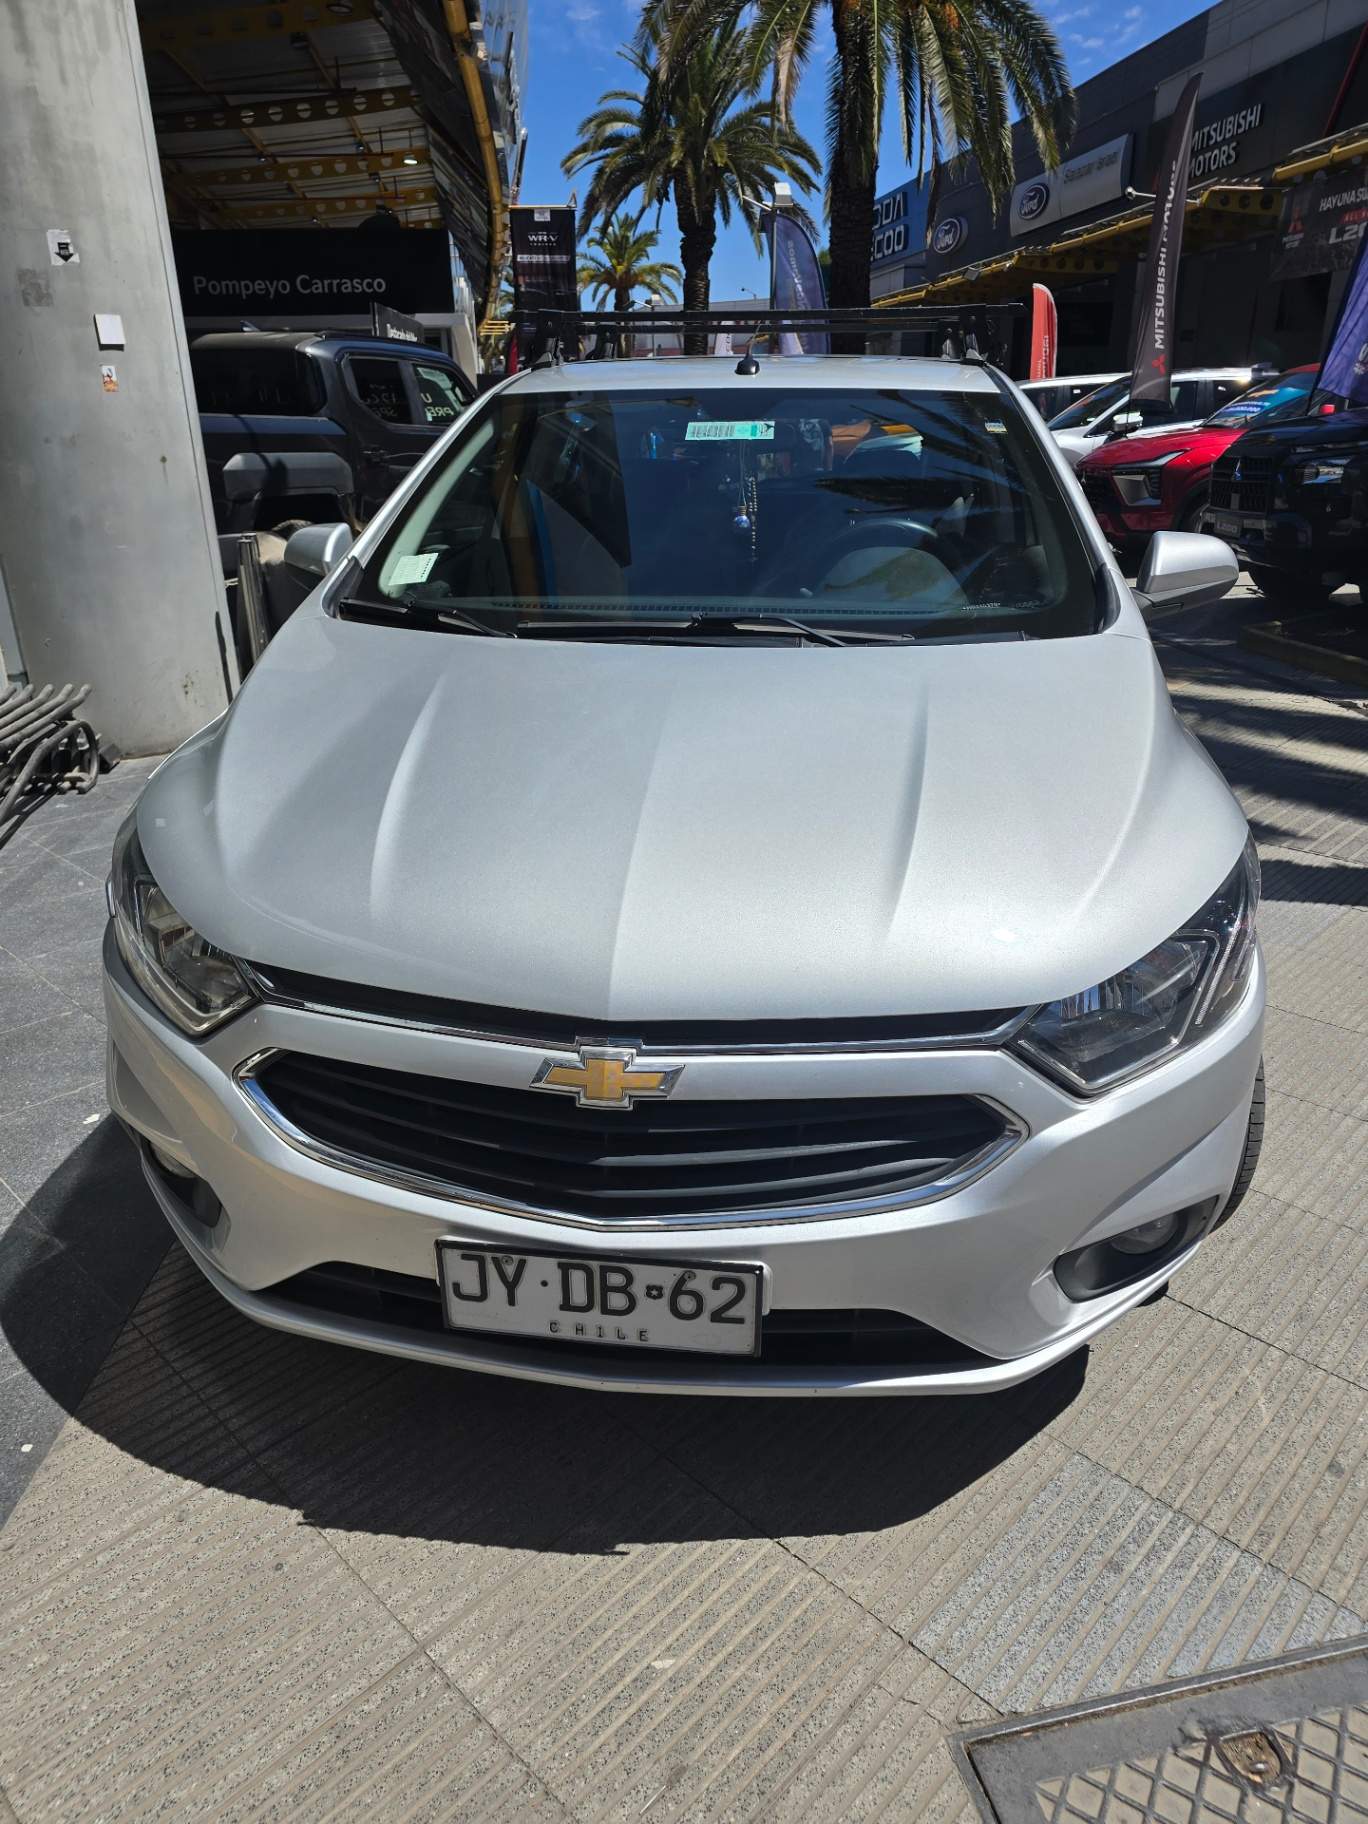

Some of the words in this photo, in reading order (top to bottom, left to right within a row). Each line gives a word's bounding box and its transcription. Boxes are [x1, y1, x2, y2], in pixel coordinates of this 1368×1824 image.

[1192, 104, 1261, 151] MITSUBISHI
[193, 275, 290, 299] Pompeyo
[296, 274, 387, 294] Carrasco
[1154, 247, 1168, 350] MITSUBISHI
[549, 1321, 649, 1342] CHILE
